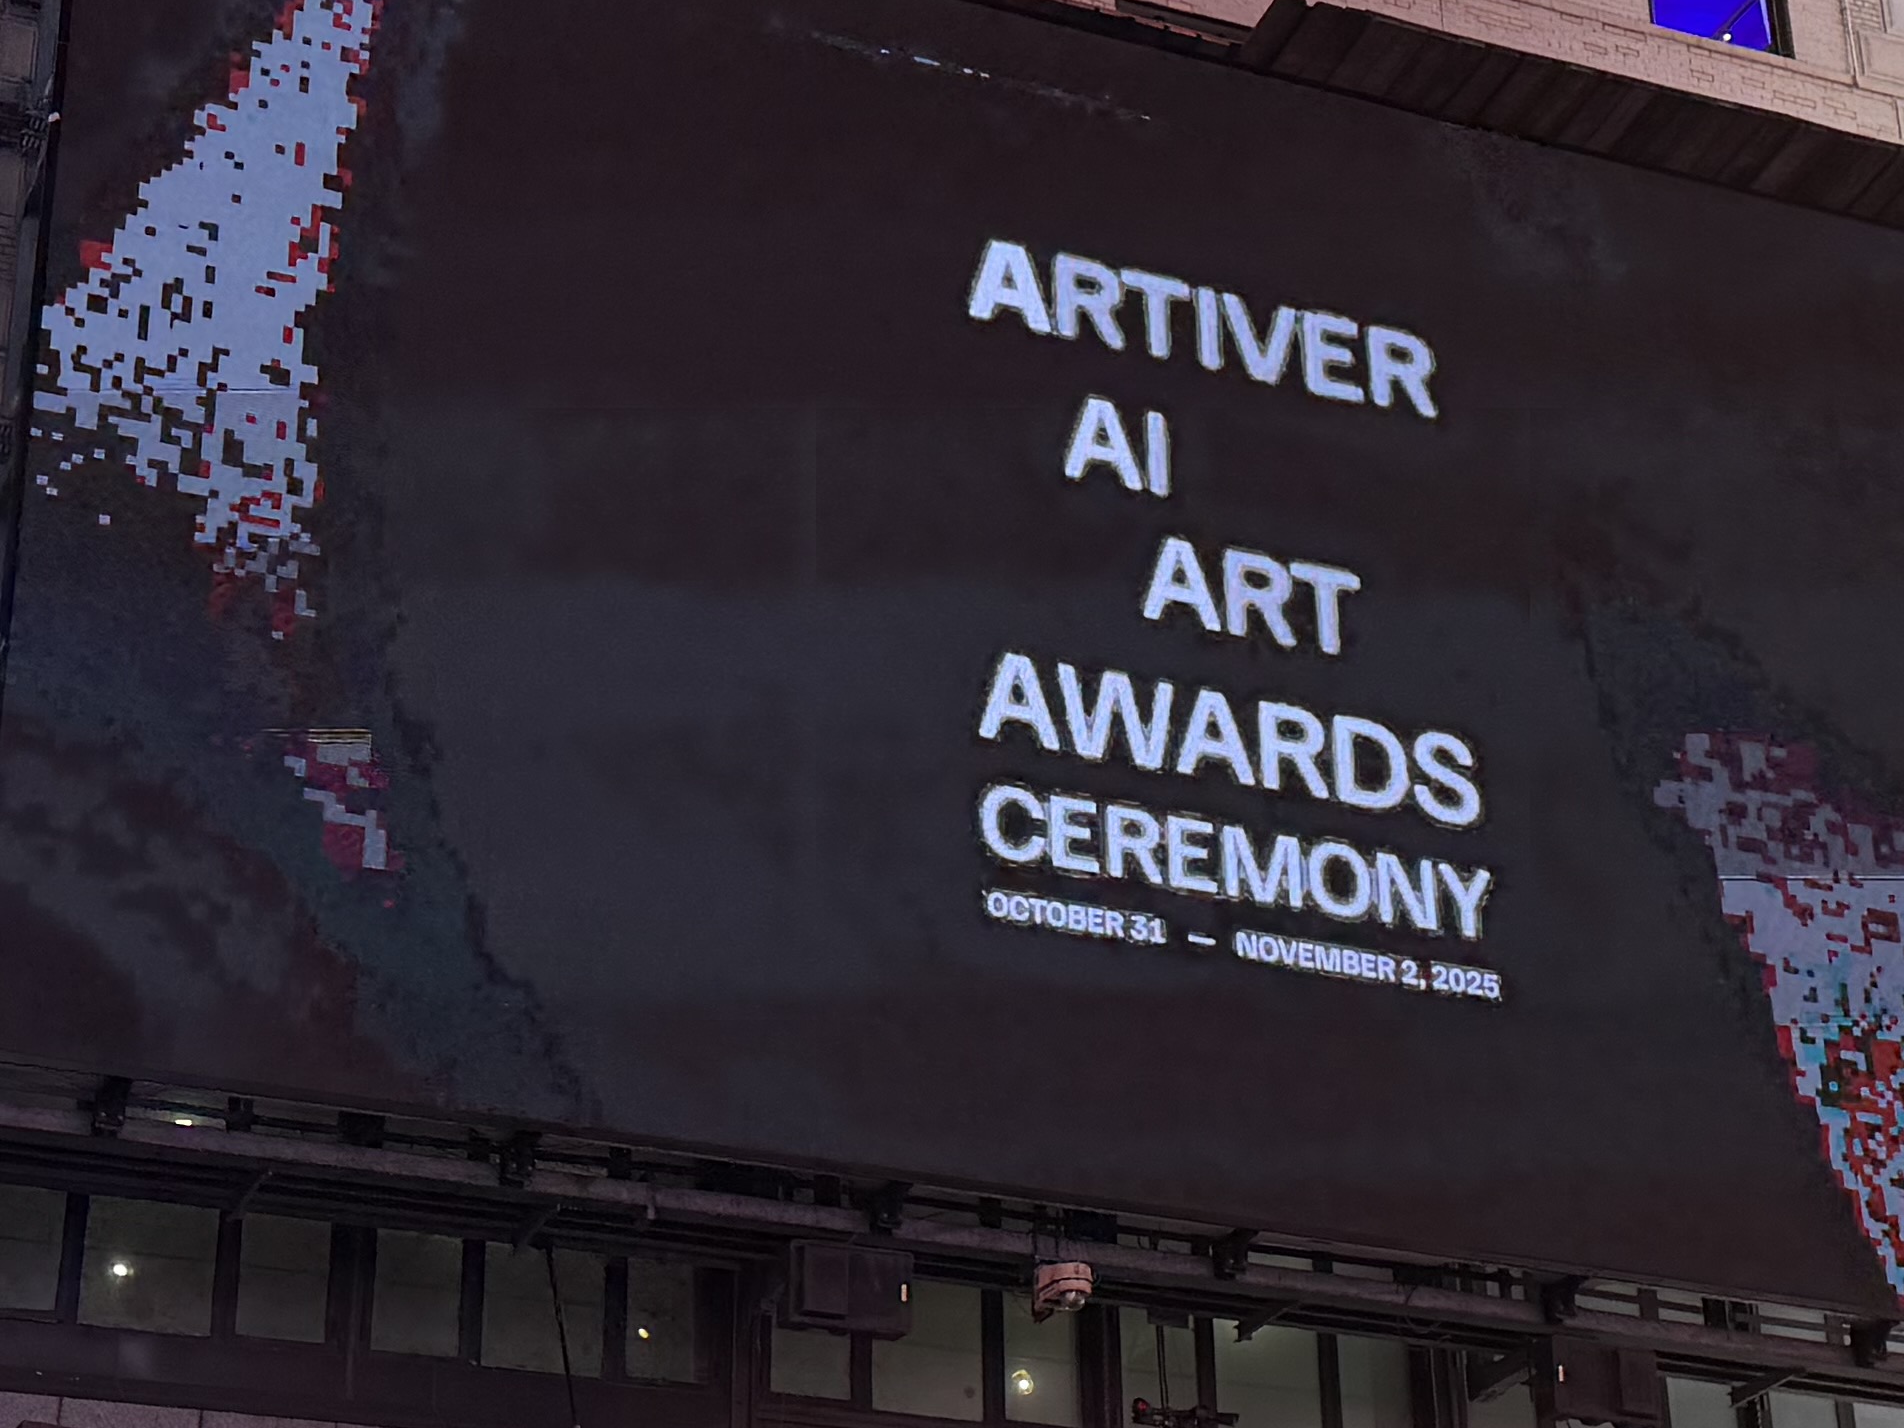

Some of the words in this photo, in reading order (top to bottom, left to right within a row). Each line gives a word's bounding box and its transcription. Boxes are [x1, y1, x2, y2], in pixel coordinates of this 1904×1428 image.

[967, 239, 1439, 418] ARTIVER
[1064, 395, 1171, 498] AI
[1142, 536, 1360, 657] ART
[978, 652, 1484, 830] AWARDS
[978, 782, 1492, 940] CEREMONY
[984, 891, 1125, 940] OCTOBER
[1129, 914, 1167, 945] 31
[1234, 930, 1398, 984] NOVEMBER
[1400, 959, 1428, 992] 2,
[1432, 964, 1502, 1001] 2025
